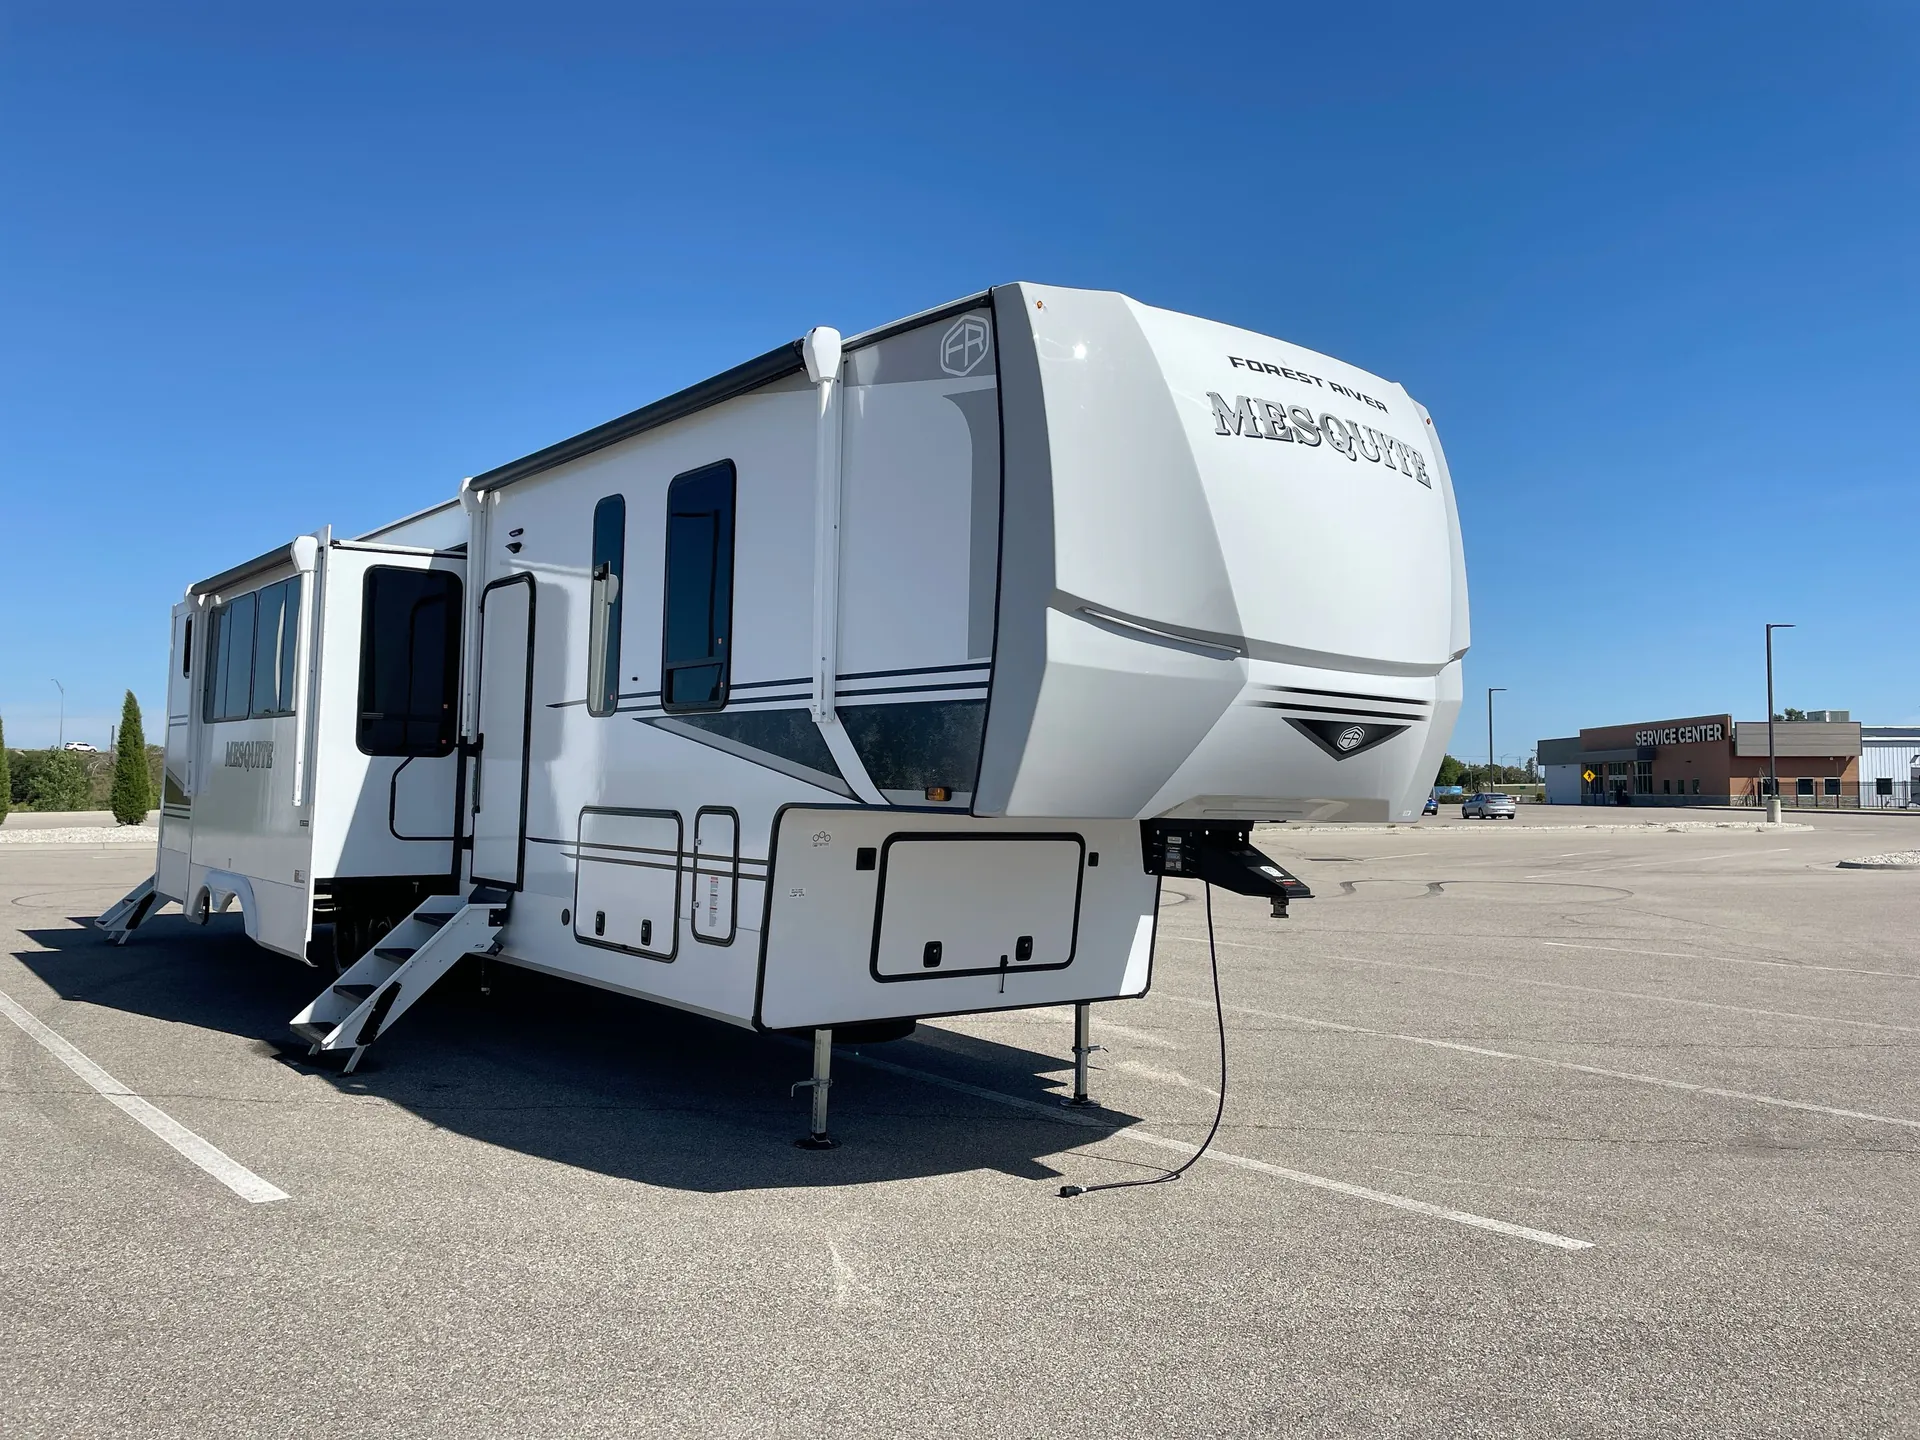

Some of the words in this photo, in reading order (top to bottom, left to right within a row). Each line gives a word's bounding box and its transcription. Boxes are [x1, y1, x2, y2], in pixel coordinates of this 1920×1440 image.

[1227, 355, 1324, 388] FOREST
[1327, 380, 1390, 415] RIVER
[1206, 391, 1432, 490] MESQUITE
[224, 740, 274, 772] MESQUITE
[1635, 728, 1677, 747] SERVICE
[1678, 723, 1723, 744] CENTER
